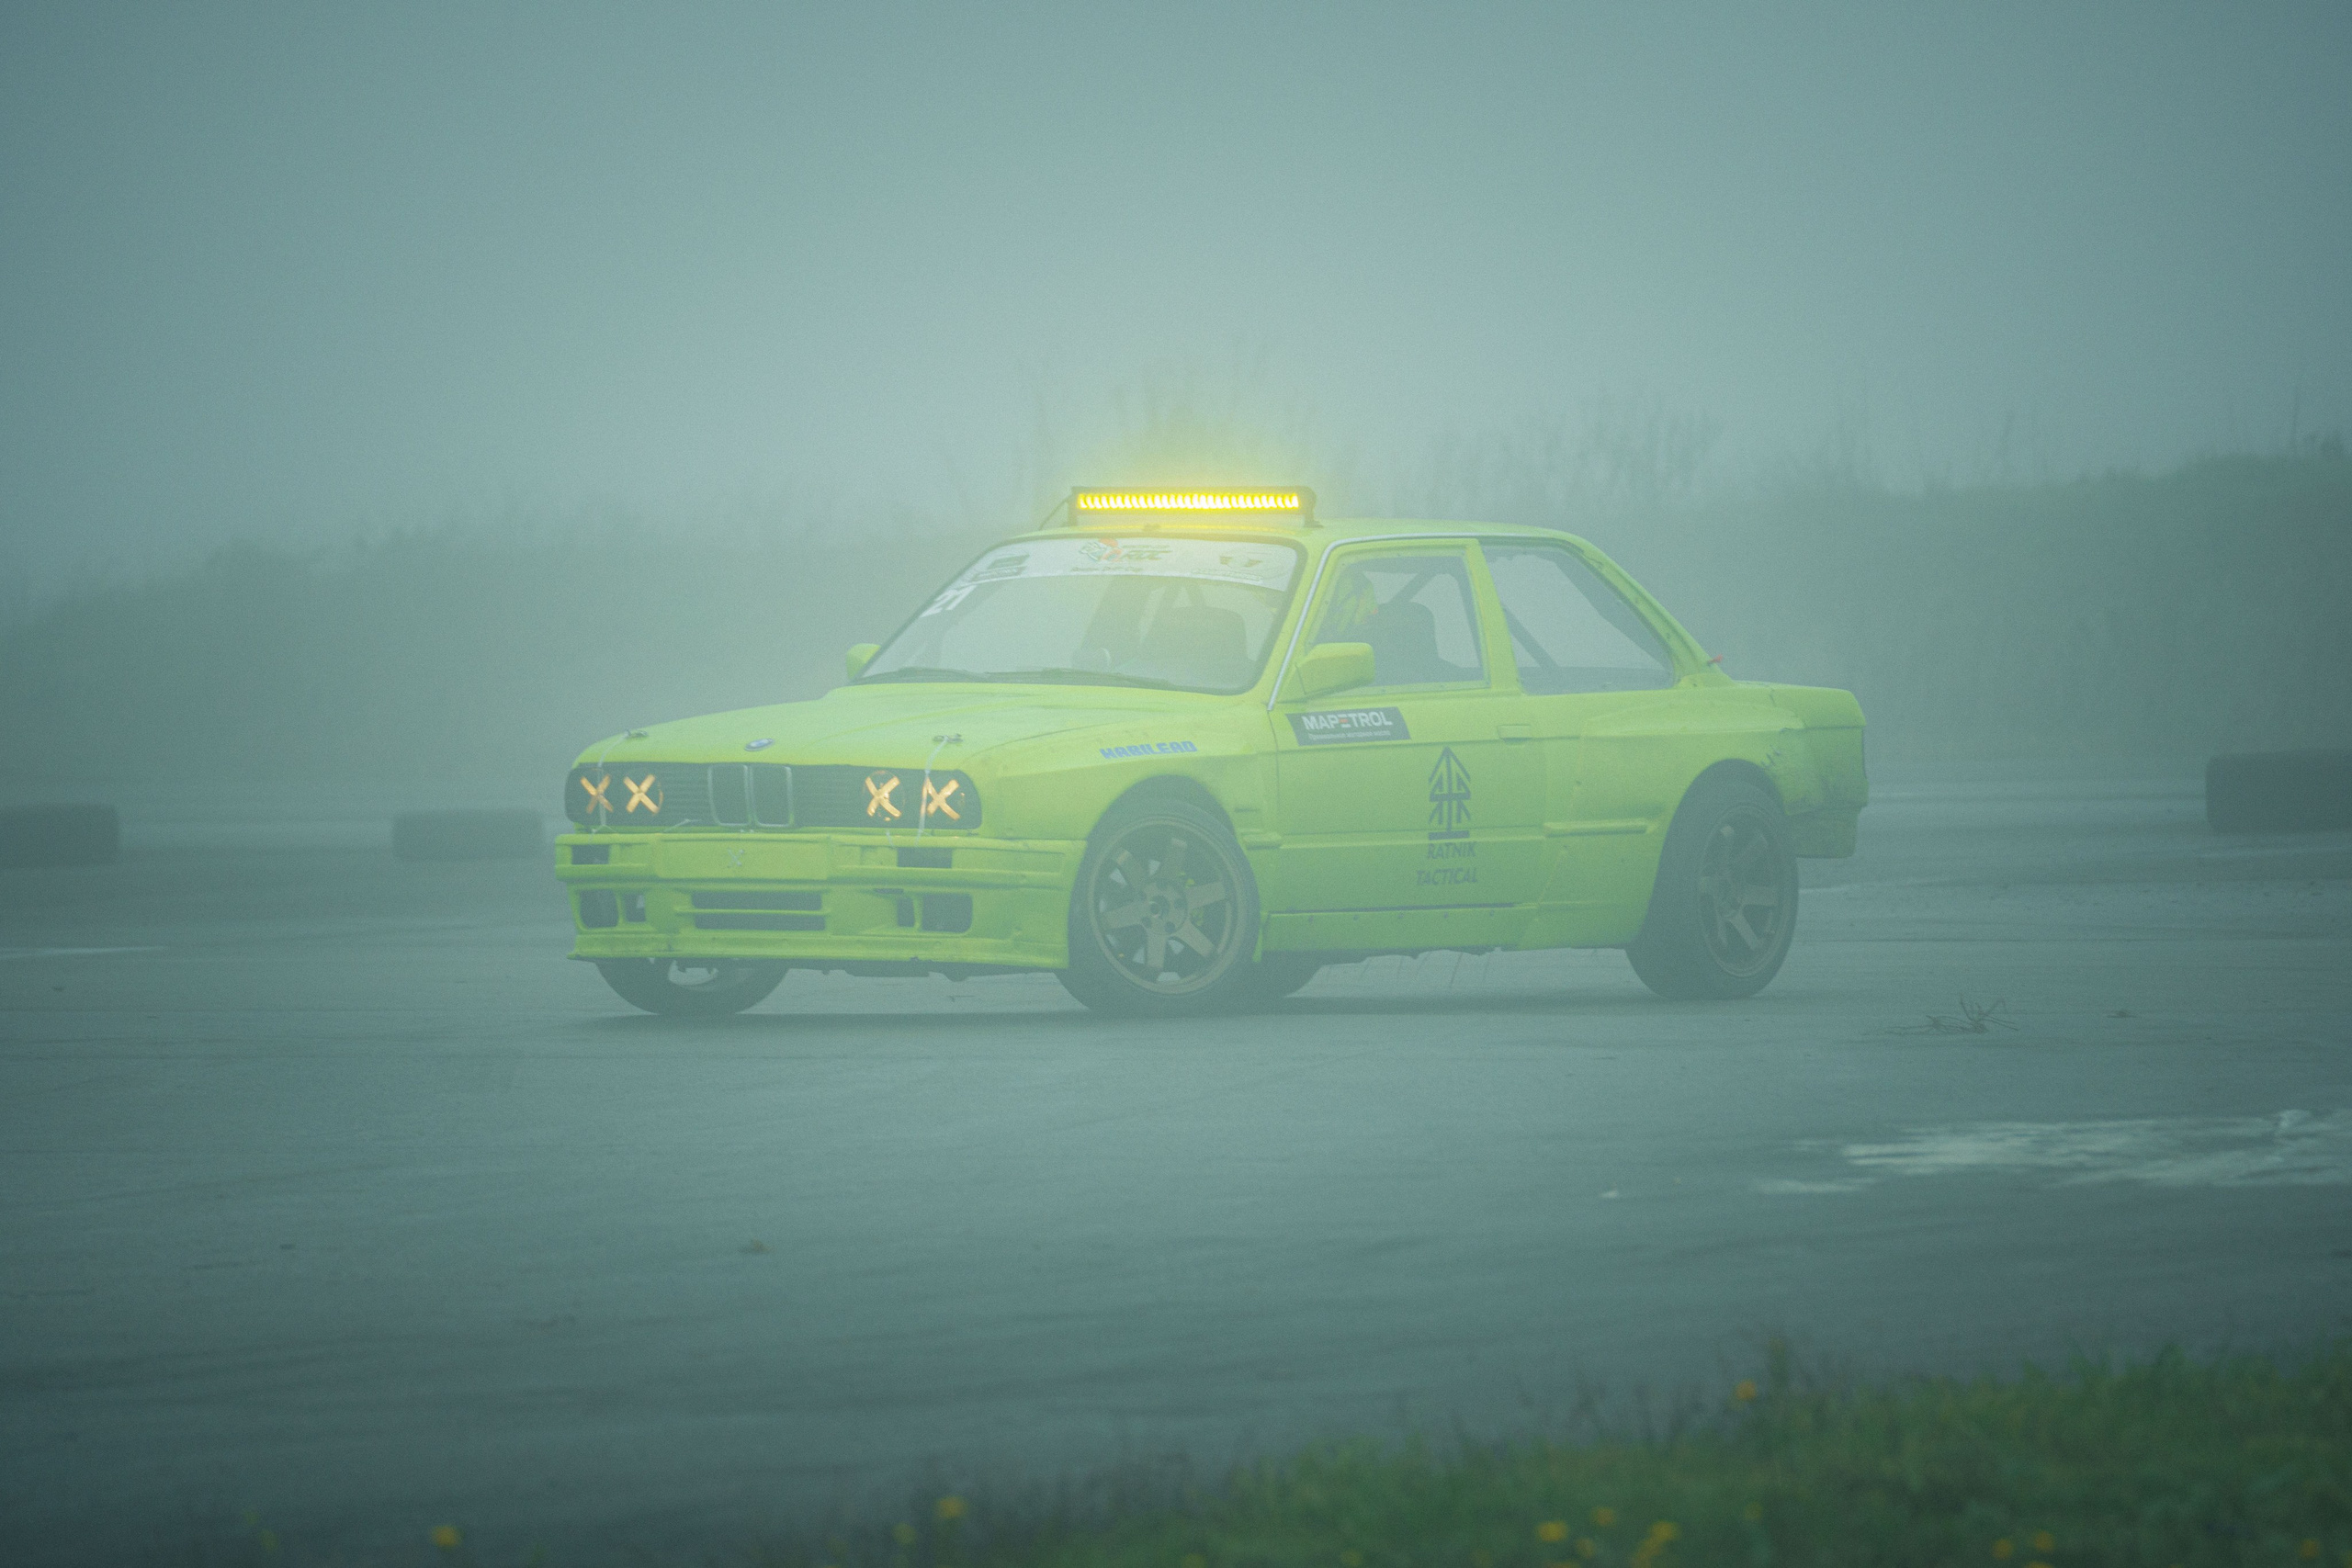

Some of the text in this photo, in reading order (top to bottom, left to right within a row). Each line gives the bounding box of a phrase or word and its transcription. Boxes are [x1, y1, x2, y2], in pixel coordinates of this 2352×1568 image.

[1301, 712, 1393, 730] MAPETROL
[1427, 840, 1477, 860] RATNIK
[1415, 866, 1478, 886] TACTICAL
